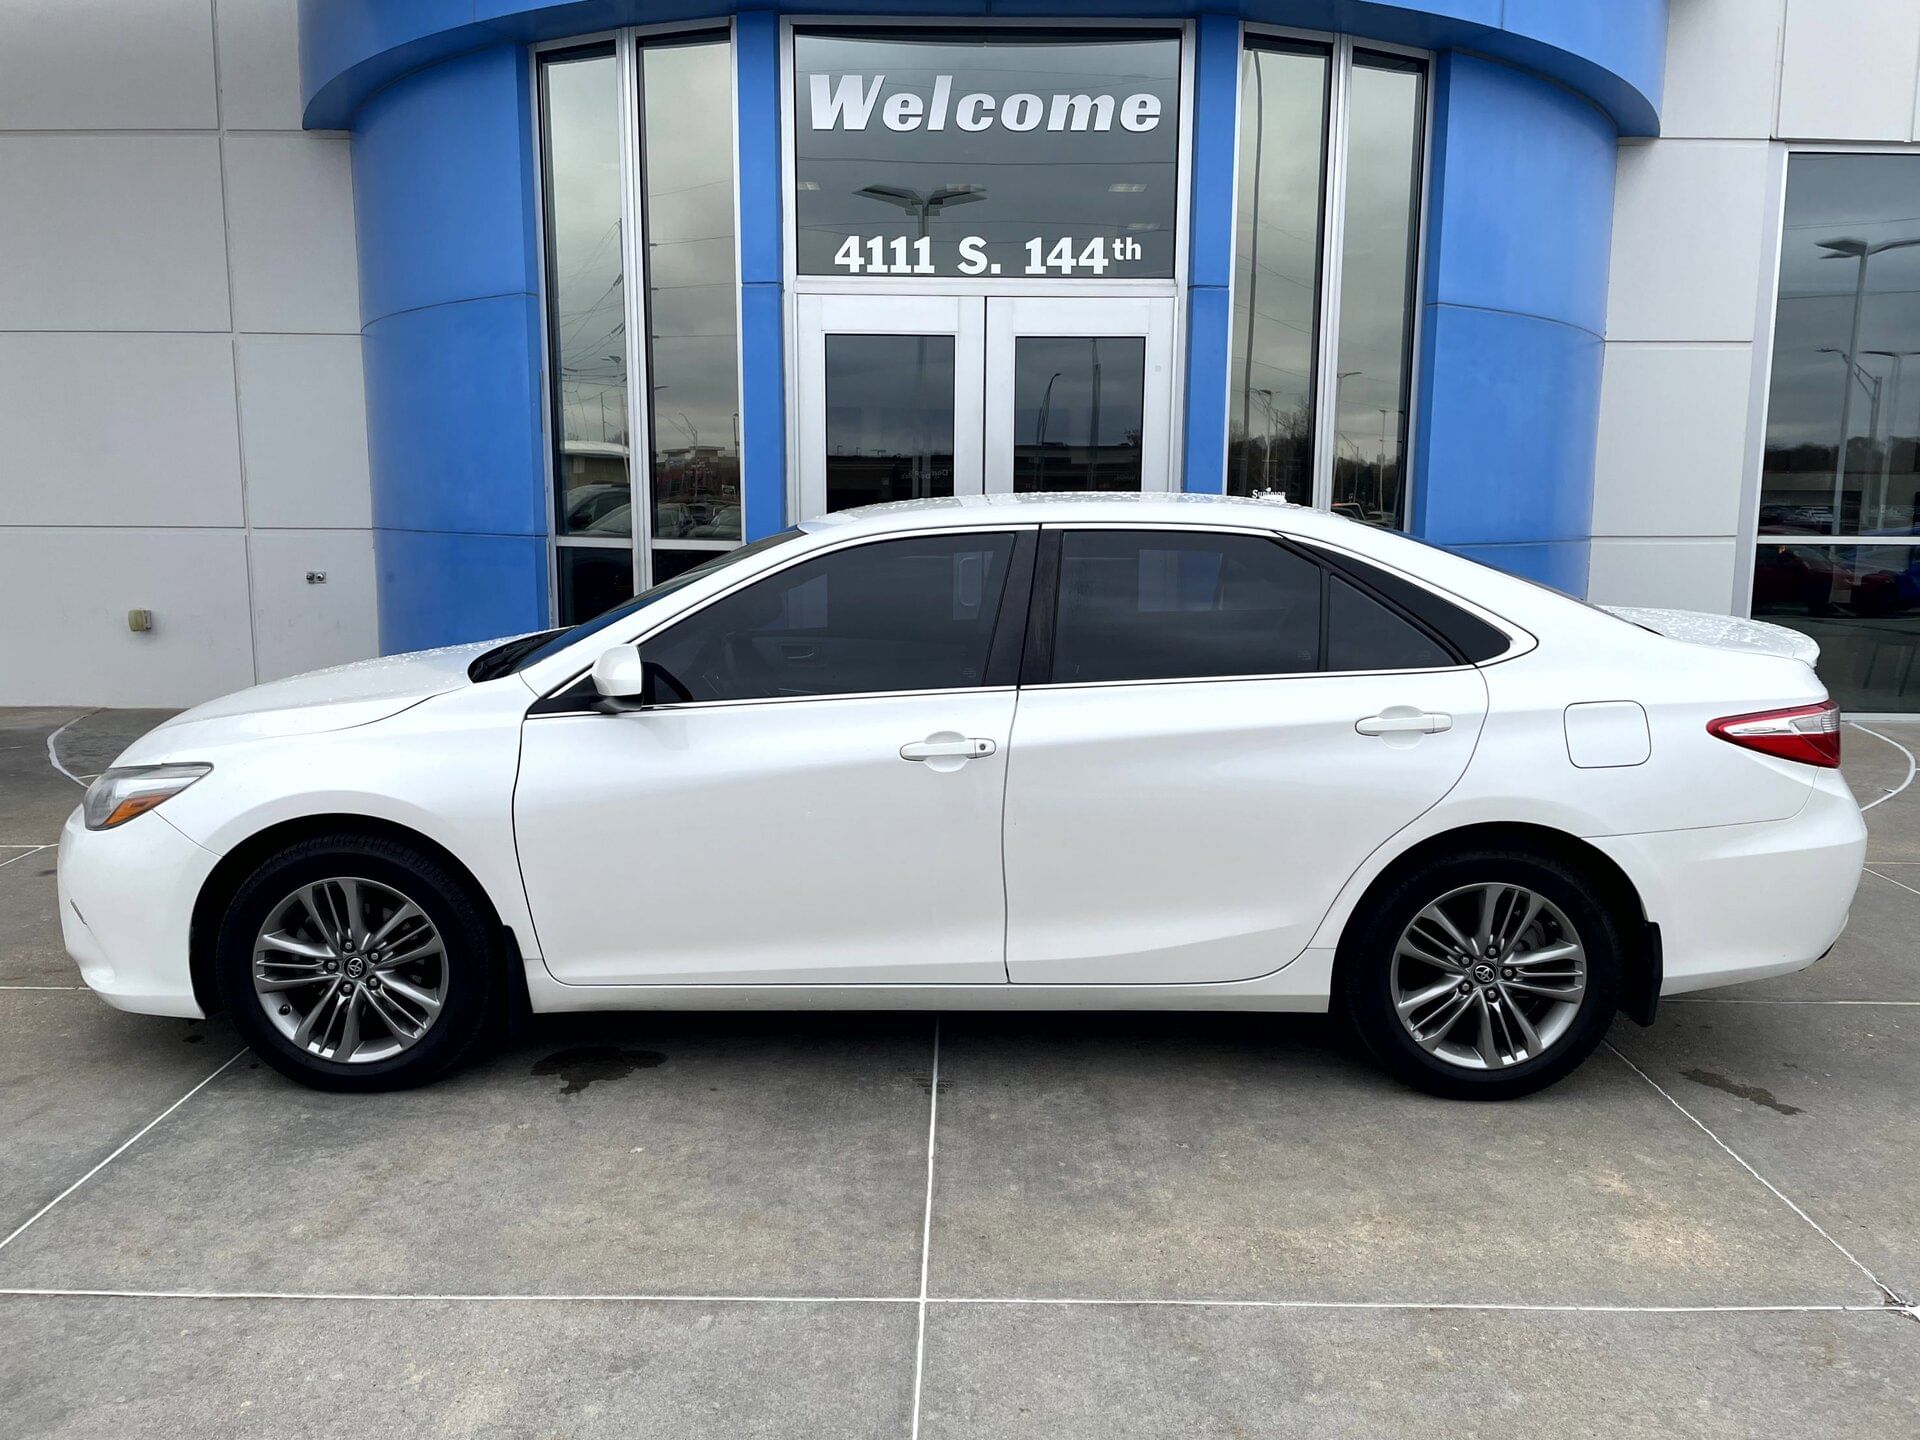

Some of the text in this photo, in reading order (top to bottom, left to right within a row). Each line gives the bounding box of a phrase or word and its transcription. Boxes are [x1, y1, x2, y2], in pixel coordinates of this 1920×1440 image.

[809, 74, 1162, 132] Welcome
[834, 235, 1142, 275] 4111 S. 144th
